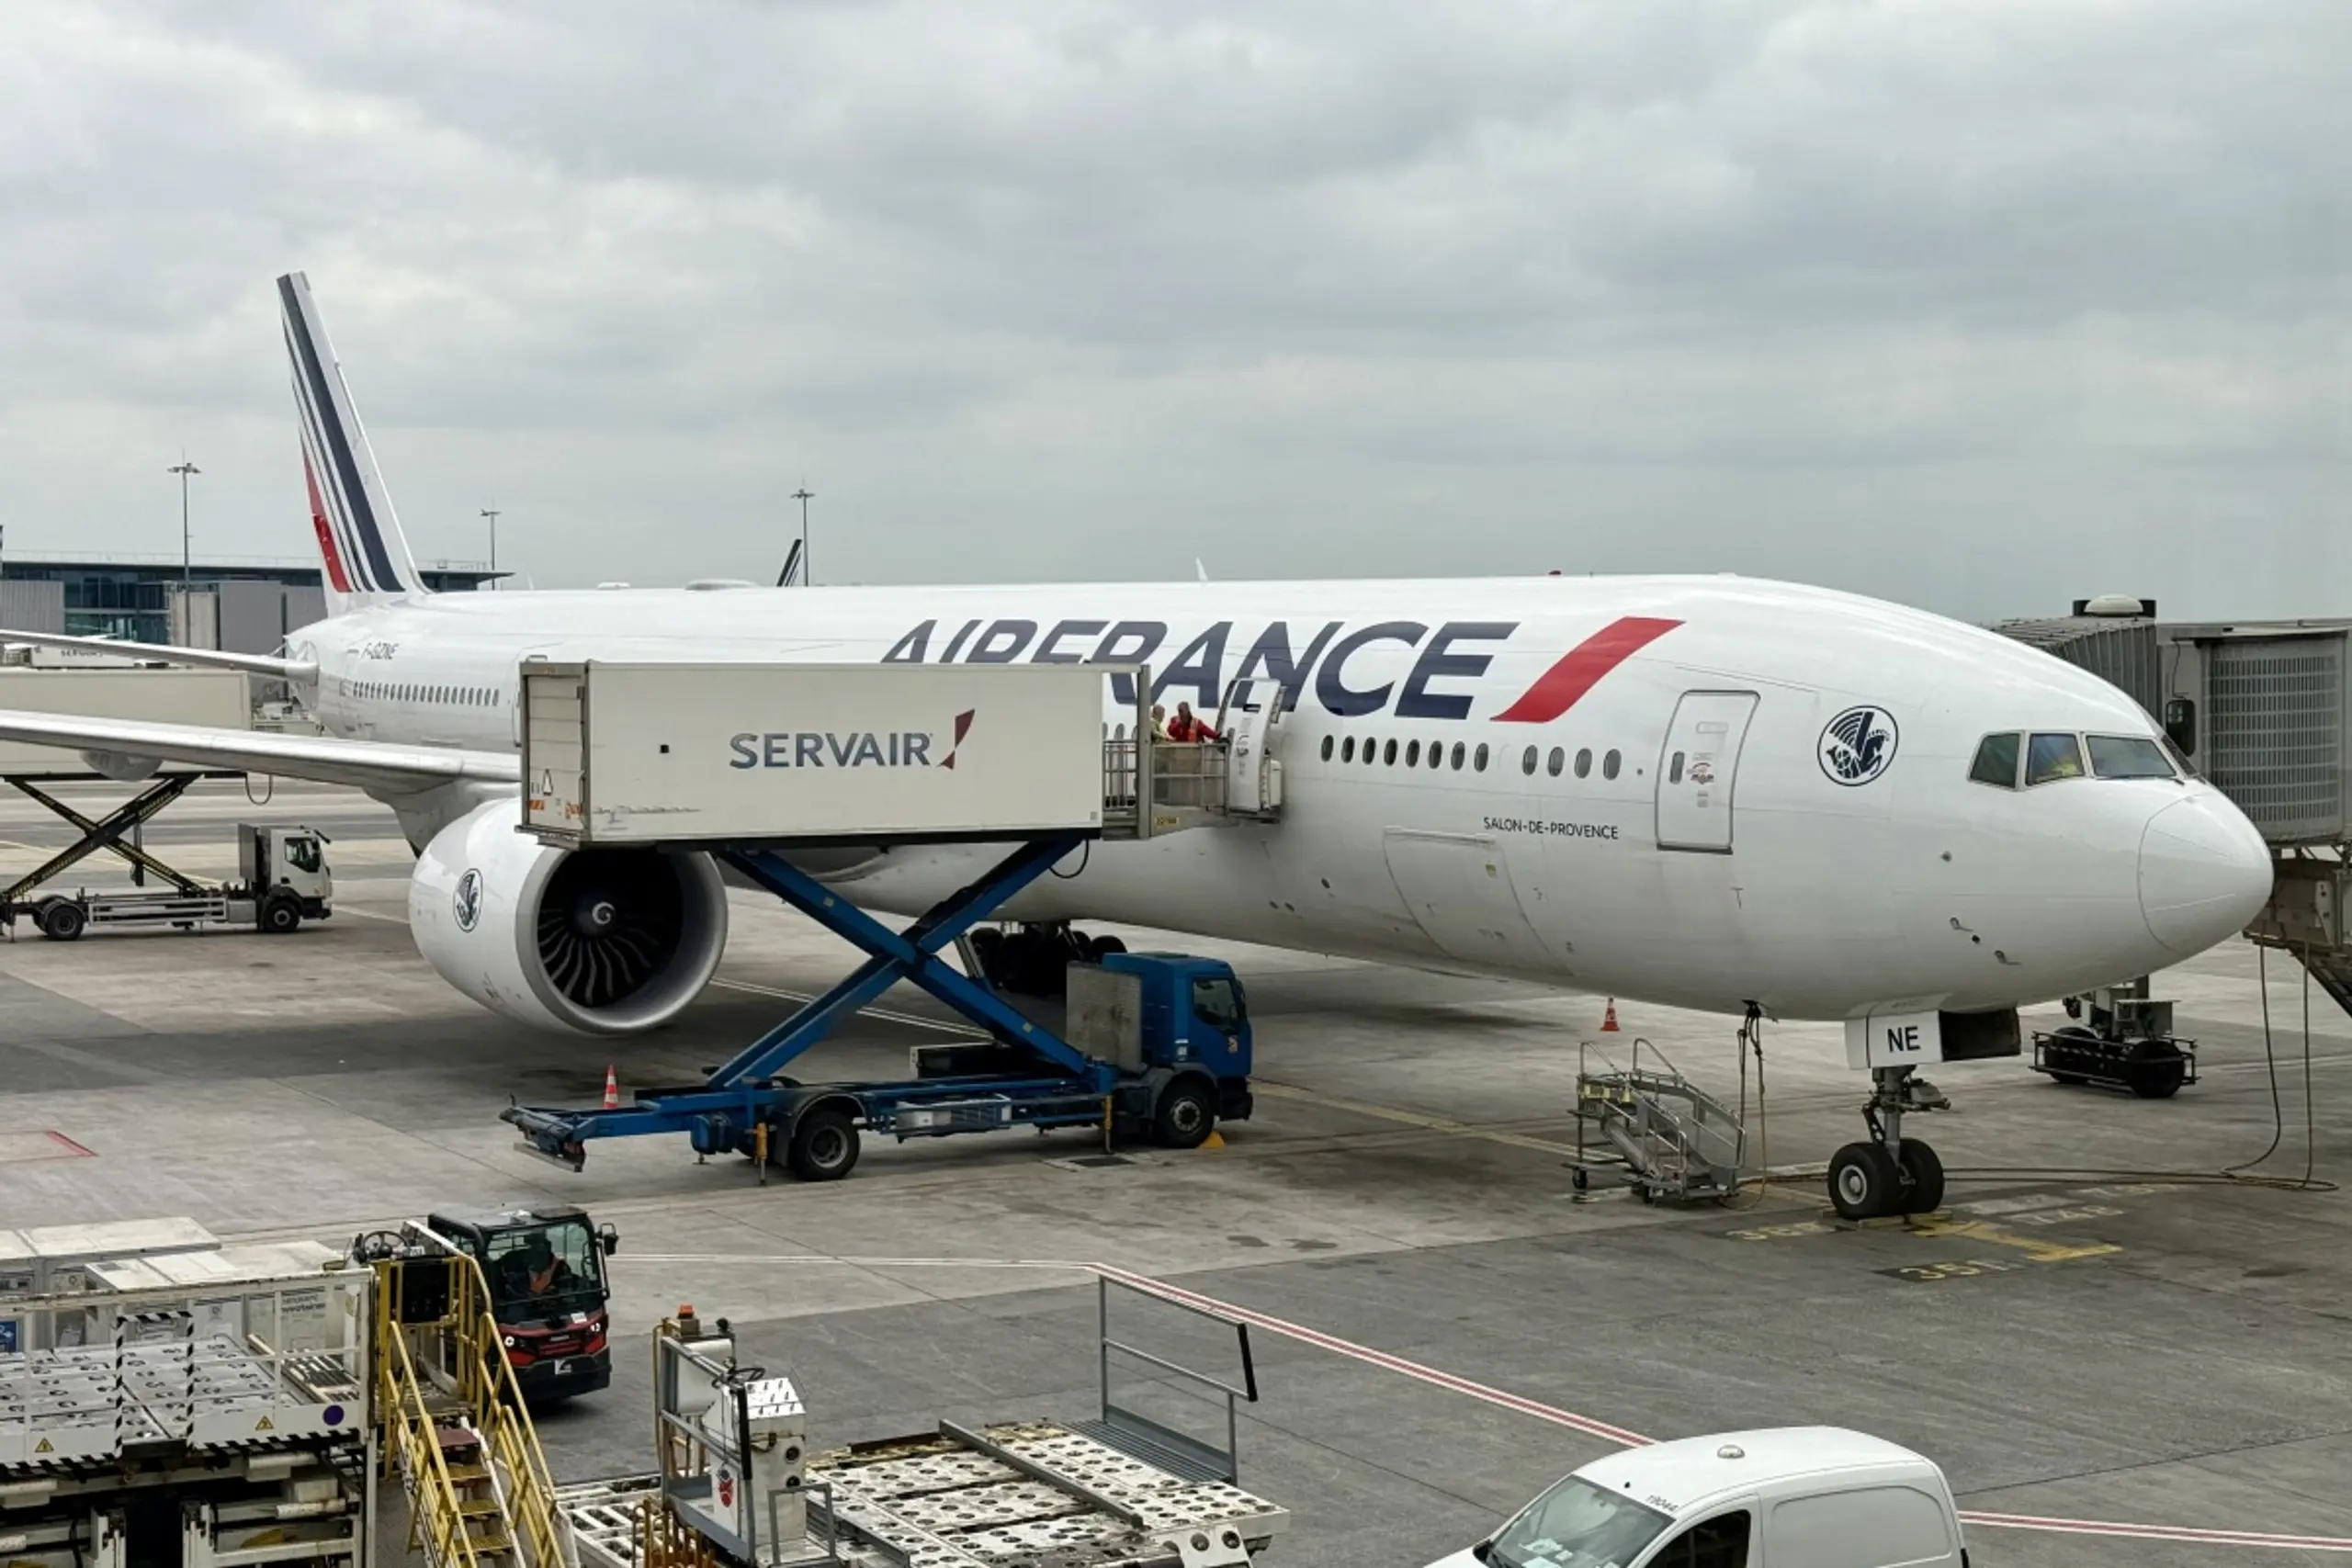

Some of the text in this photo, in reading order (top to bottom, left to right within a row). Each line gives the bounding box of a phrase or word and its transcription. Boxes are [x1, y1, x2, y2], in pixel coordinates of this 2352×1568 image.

[729, 731, 932, 770] SERVAIR
[1483, 817, 1620, 840] SALON-DE-PROVENCE
[1886, 1025, 1921, 1054] NE
